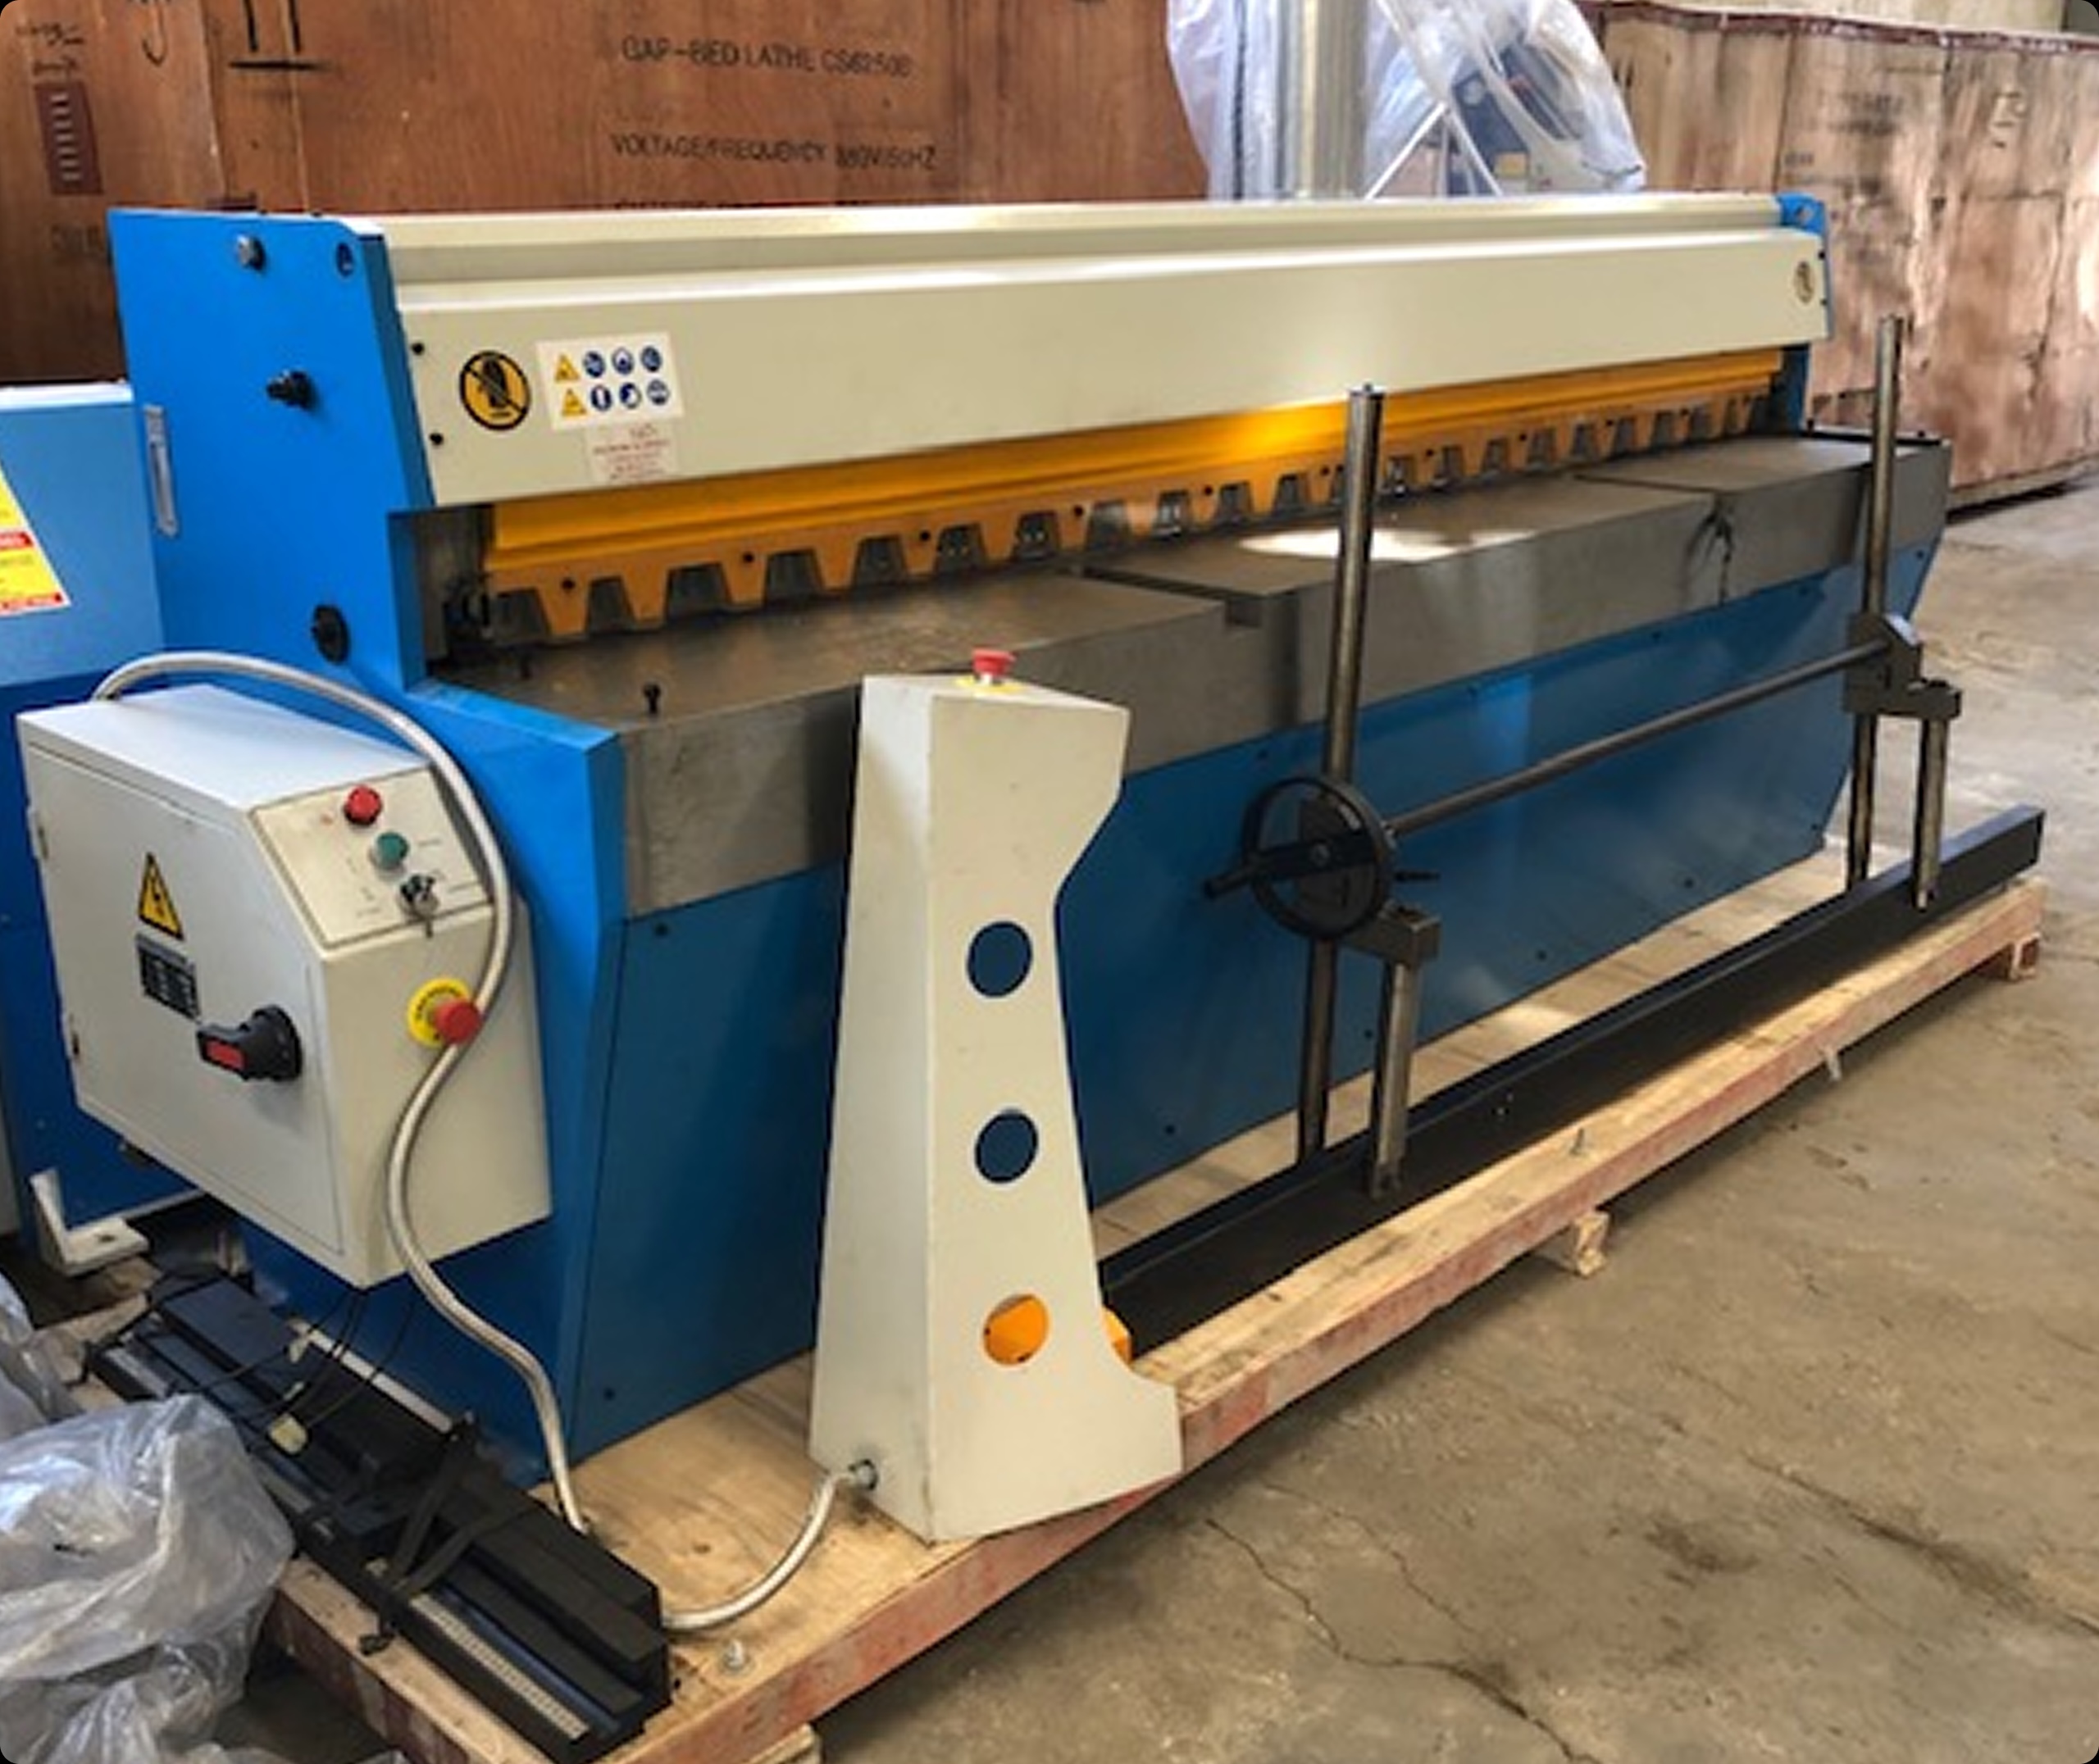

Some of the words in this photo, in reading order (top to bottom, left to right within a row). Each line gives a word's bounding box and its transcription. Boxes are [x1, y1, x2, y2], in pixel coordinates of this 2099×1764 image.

[622, 35, 740, 67] GAP-BED
[744, 43, 816, 73] LATHE
[611, 134, 826, 162] VOLTAGE/FREQUENCY
